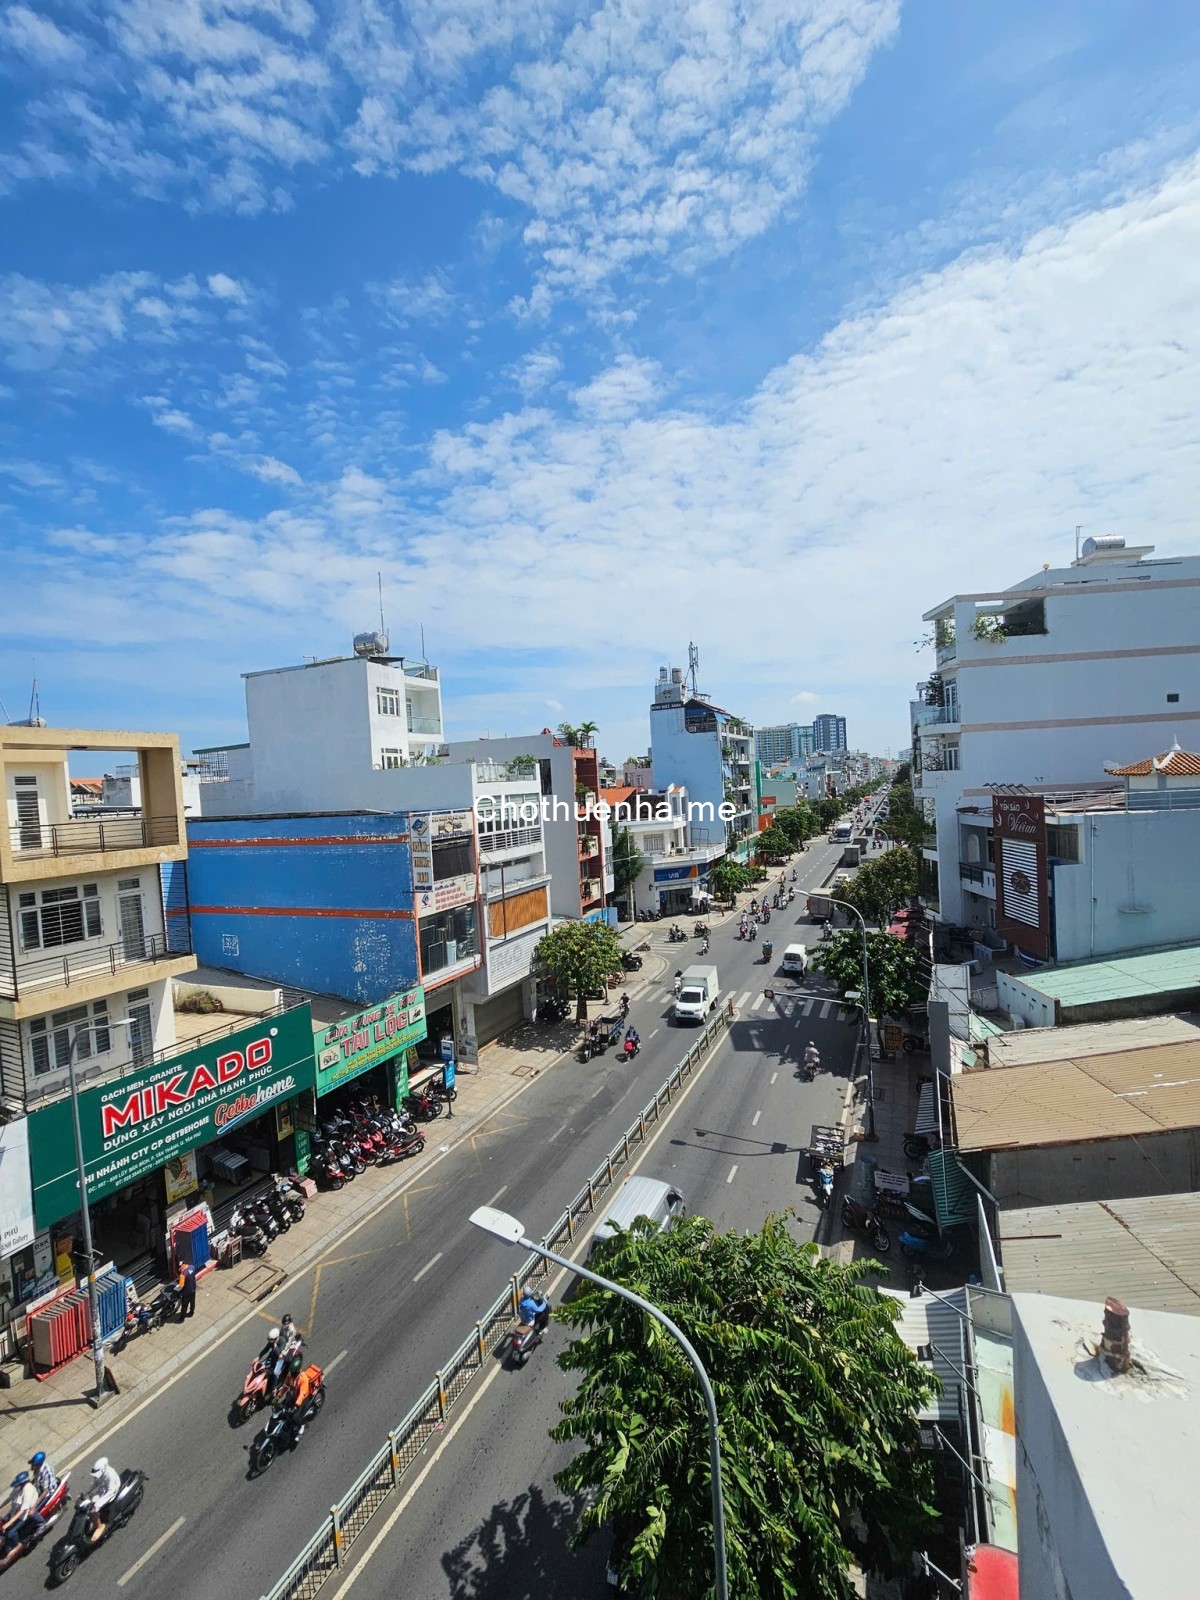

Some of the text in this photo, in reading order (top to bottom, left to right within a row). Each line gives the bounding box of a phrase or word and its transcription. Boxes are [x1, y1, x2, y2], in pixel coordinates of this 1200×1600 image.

[340, 1029, 370, 1057] TÀI
[374, 1010, 408, 1040] LỘC
[101, 1088, 126, 1103] GẠCH
[127, 1080, 144, 1092] MEN
[150, 1064, 182, 1082] GRANITE
[101, 1038, 272, 1138] MIKADO
[104, 1065, 273, 1151] DỰNG XÂY NGÔI NHÀ HẠNH PHÚC
[96, 1156, 130, 1179] NHÁNH
[131, 1146, 149, 1160] CTY
[151, 1140, 164, 1150] CP
[165, 1116, 210, 1143] GETBEHOME
